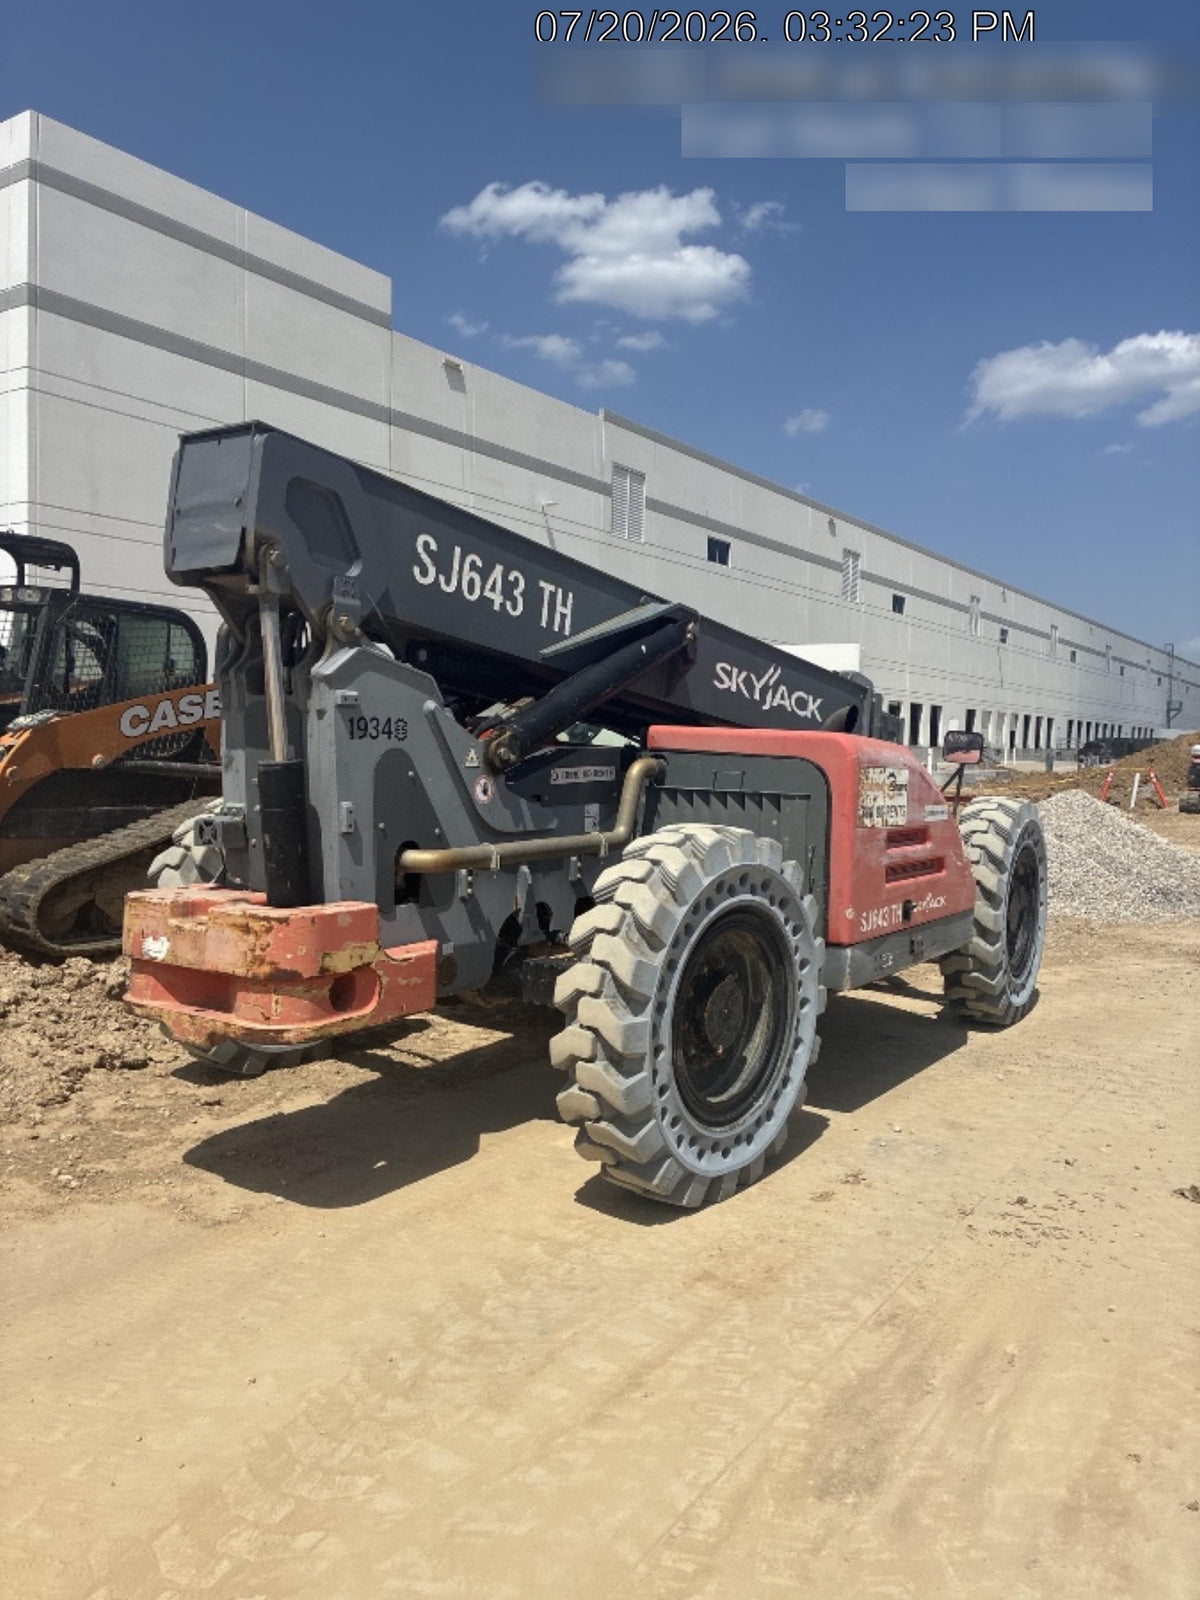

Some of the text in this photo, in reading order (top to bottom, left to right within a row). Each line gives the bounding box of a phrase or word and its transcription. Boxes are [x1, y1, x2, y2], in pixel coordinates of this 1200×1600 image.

[412, 533, 573, 636] SJ643 TH
[120, 690, 222, 738] CASE
[713, 662, 824, 722] SKYJACK
[890, 902, 903, 924] TH
